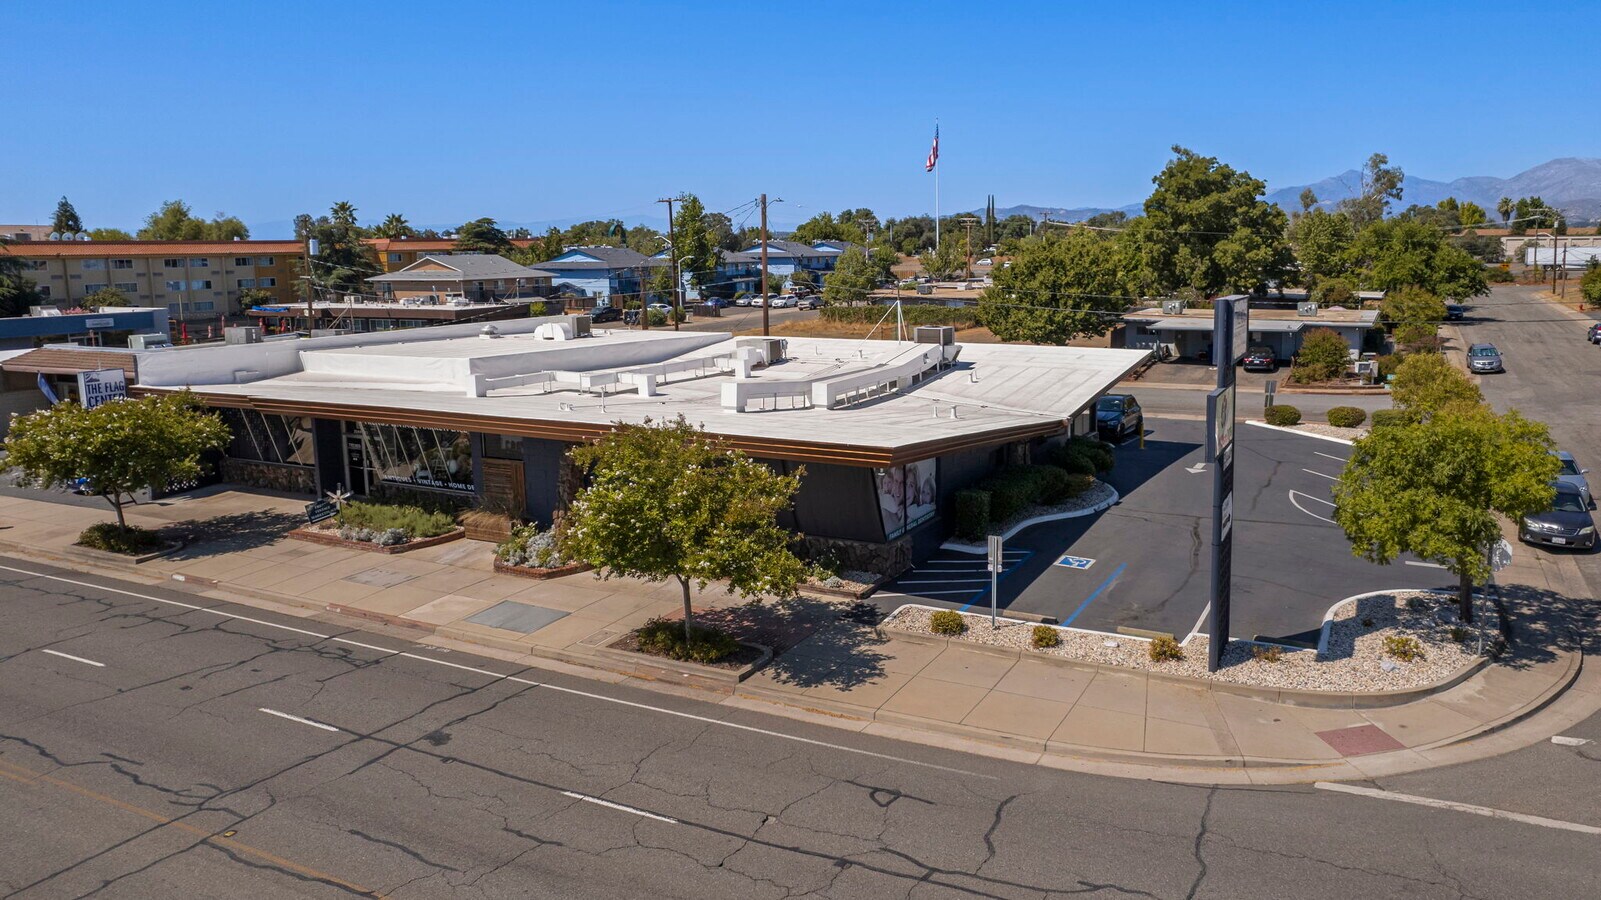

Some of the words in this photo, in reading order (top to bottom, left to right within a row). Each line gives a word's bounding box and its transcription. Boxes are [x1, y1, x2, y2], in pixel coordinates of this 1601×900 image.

[87, 383, 102, 394] THE
[105, 381, 125, 392] FLAG
[384, 475, 412, 483] ANTIQUES
[418, 479, 443, 487] VINTAGE
